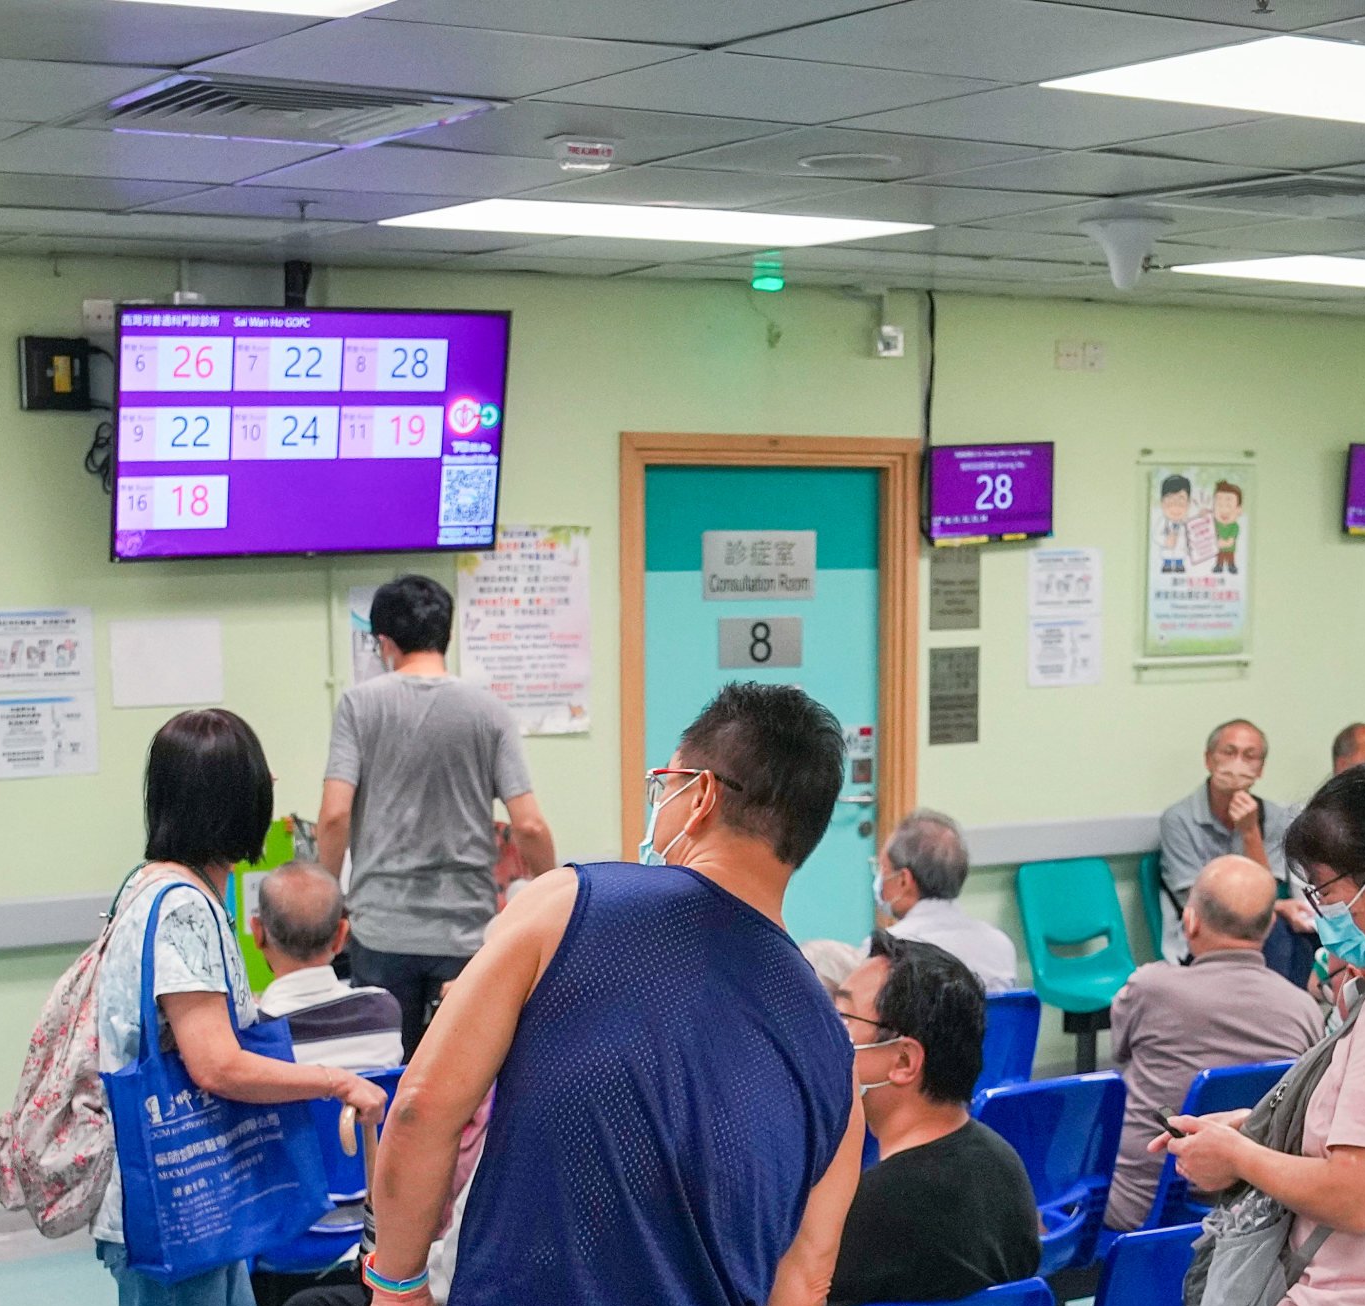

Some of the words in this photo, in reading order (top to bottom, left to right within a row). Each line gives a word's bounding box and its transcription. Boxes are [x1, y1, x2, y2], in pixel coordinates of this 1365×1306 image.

[233, 316, 247, 328] Sai
[248, 316, 268, 328] Wan
[269, 316, 283, 328] Ho
[135, 354, 145, 372] 6
[173, 345, 214, 378] 26
[248, 355, 258, 372] 7
[284, 346, 323, 378] 22
[356, 356, 366, 372] 8
[391, 347, 429, 378] 28
[133, 424, 144, 442] 9
[171, 416, 210, 448] 22
[241, 424, 261, 441] 10
[281, 415, 319, 446] 24
[349, 423, 366, 440] 11
[390, 415, 426, 446] 19
[127, 494, 147, 512] 16
[172, 484, 209, 516] 18
[975, 474, 1013, 511] 28
[709, 573, 775, 593] Consultation
[778, 573, 810, 592] Room
[750, 622, 772, 663] 8
